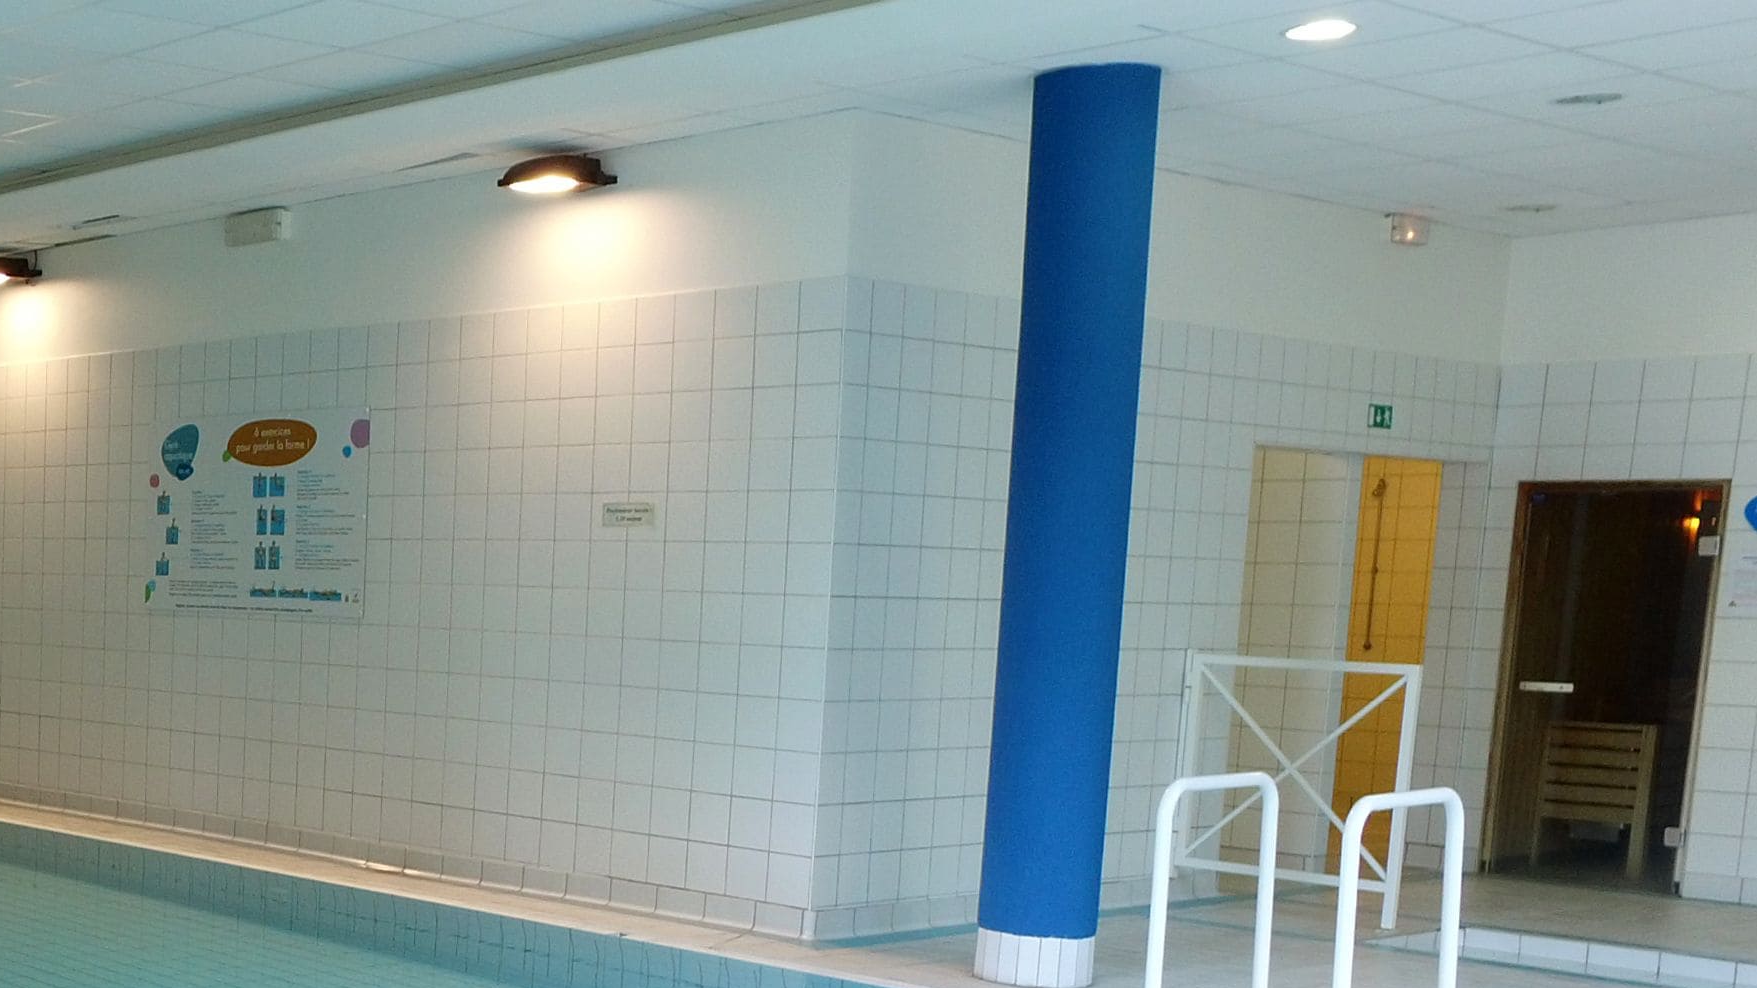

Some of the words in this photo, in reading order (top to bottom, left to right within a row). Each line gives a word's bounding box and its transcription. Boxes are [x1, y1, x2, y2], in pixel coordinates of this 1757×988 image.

[260, 428, 291, 437] exercices
[236, 444, 251, 454] pour
[252, 440, 275, 454] garder
[276, 440, 284, 450] la
[285, 439, 305, 449] forme
